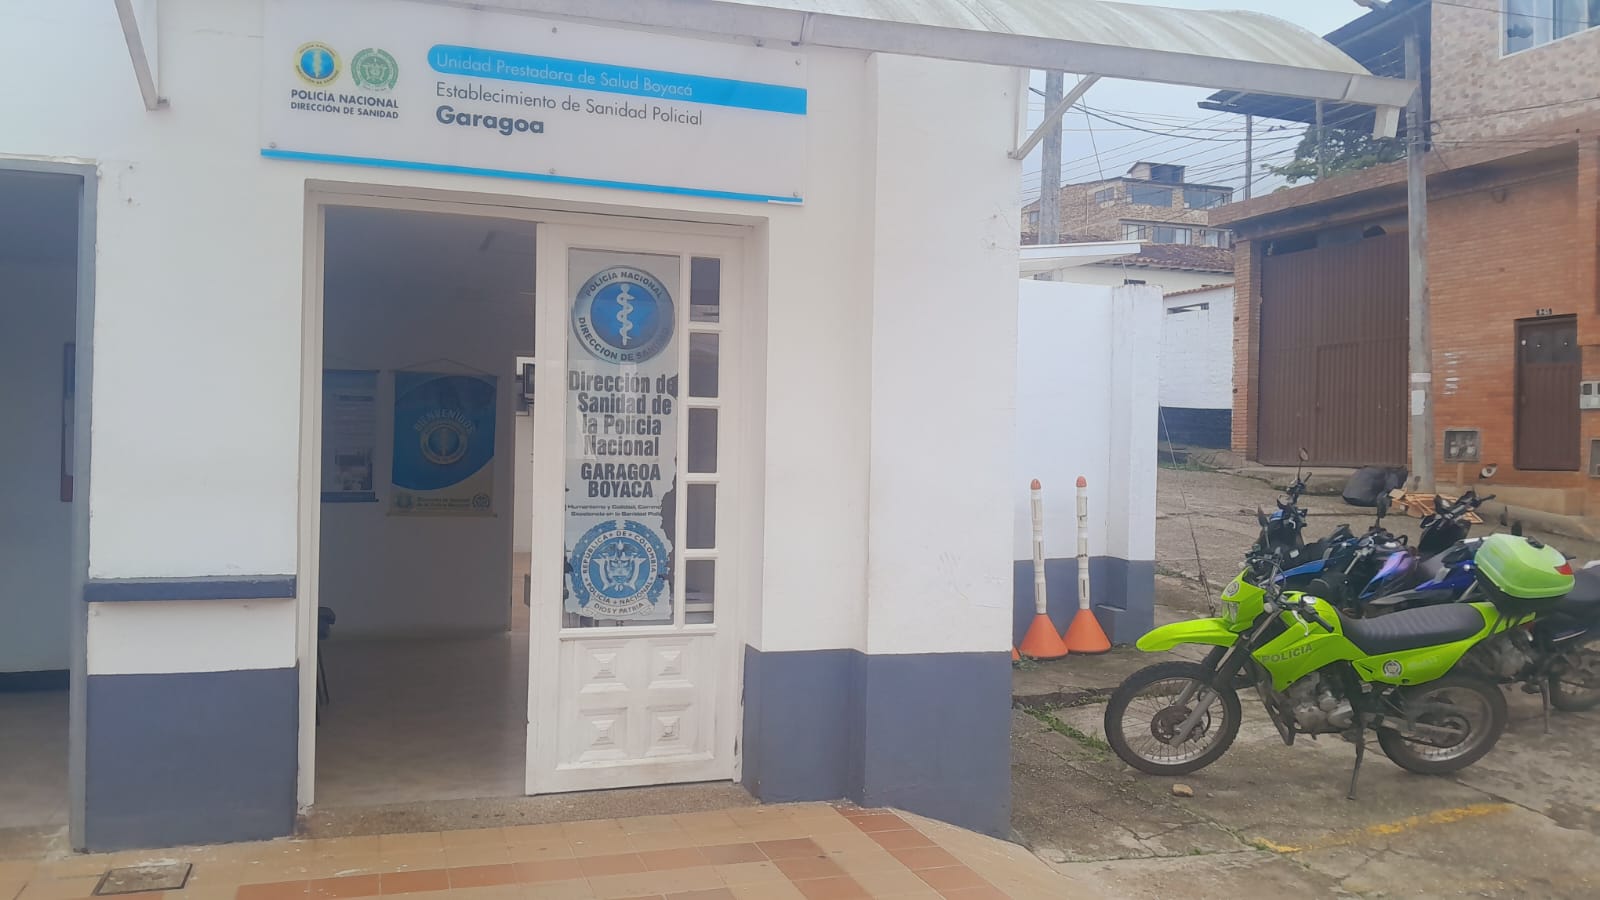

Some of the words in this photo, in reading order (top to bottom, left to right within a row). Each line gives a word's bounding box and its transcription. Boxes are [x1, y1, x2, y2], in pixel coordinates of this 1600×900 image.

[437, 52, 491, 72] Unidad
[496, 59, 573, 81] Prestadora
[578, 68, 596, 84] de
[601, 71, 639, 89] Salud
[643, 77, 693, 96] Boyacá
[290, 102, 340, 114] DIRECCIÓN
[343, 107, 354, 115] DE
[357, 108, 399, 119] SANIDAD
[339, 94, 399, 109] NACIONAL
[436, 81, 557, 109] Establecimiento
[561, 95, 581, 112] de
[586, 98, 647, 119] Sanidad
[653, 106, 702, 126] Policial
[436, 105, 544, 136] Garagoa
[621, 271, 662, 297] NACIONAL
[621, 353, 634, 361] DE
[568, 370, 650, 393] Dirección
[578, 392, 646, 415] Sanidad
[652, 395, 672, 415] de
[582, 414, 598, 434] la
[584, 435, 659, 456] Nacional
[581, 463, 661, 481] GARAGOA
[588, 481, 653, 498] BOYACA
[634, 534, 657, 573] COLOMBIA
[619, 581, 652, 605] NACIONAL
